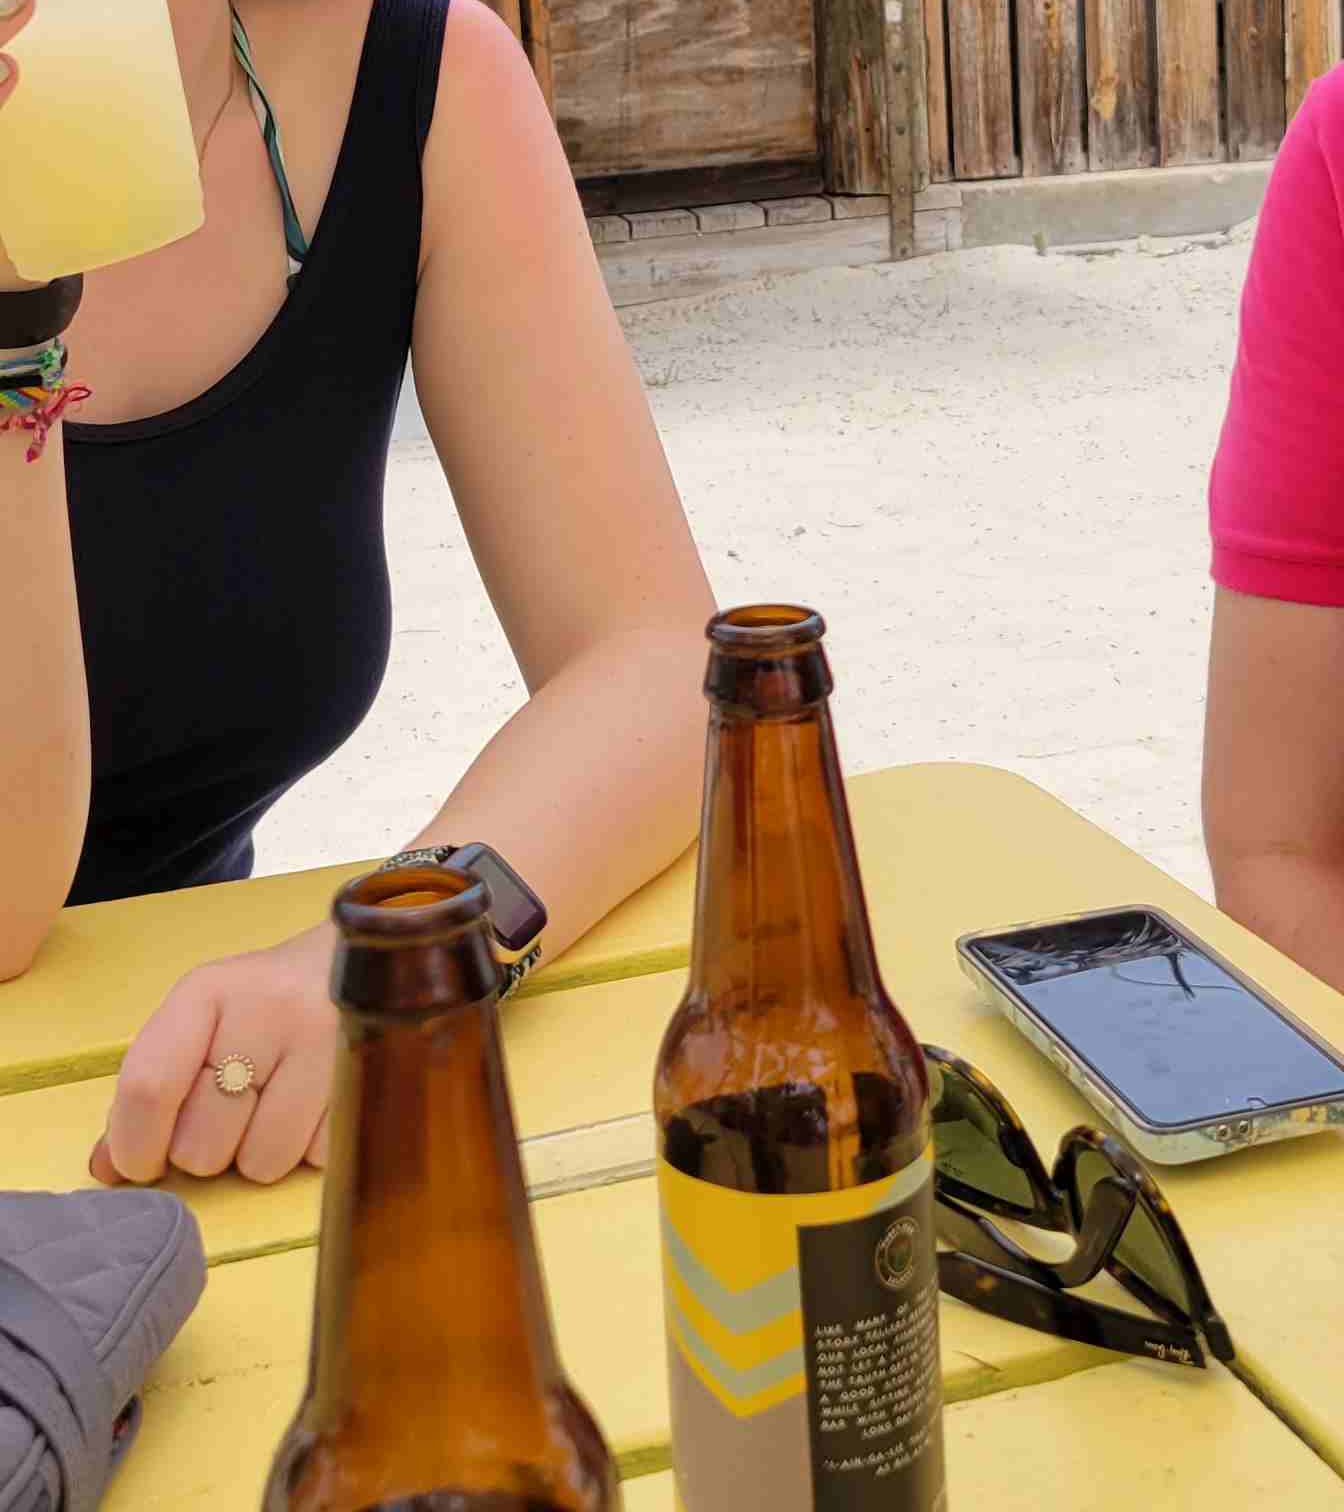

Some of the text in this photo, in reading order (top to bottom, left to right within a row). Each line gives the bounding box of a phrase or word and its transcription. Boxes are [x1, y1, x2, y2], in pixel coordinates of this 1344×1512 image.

[816, 1322, 843, 1336] LIKE
[816, 1335, 859, 1351] STORY
[816, 1339, 888, 1364] OUR LOCAL
[817, 1363, 845, 1378] NOT
[850, 1357, 873, 1374] LET
[878, 1353, 888, 1368] A
[819, 1377, 843, 1390] THE
[848, 1367, 888, 1387] TRUTH
[820, 1393, 830, 1404] A
[840, 1384, 876, 1402] GOOD
[822, 1400, 860, 1417] WHILE
[820, 1417, 848, 1432] BAR
[856, 1409, 888, 1427] WITH
[863, 1420, 893, 1439] LONG
